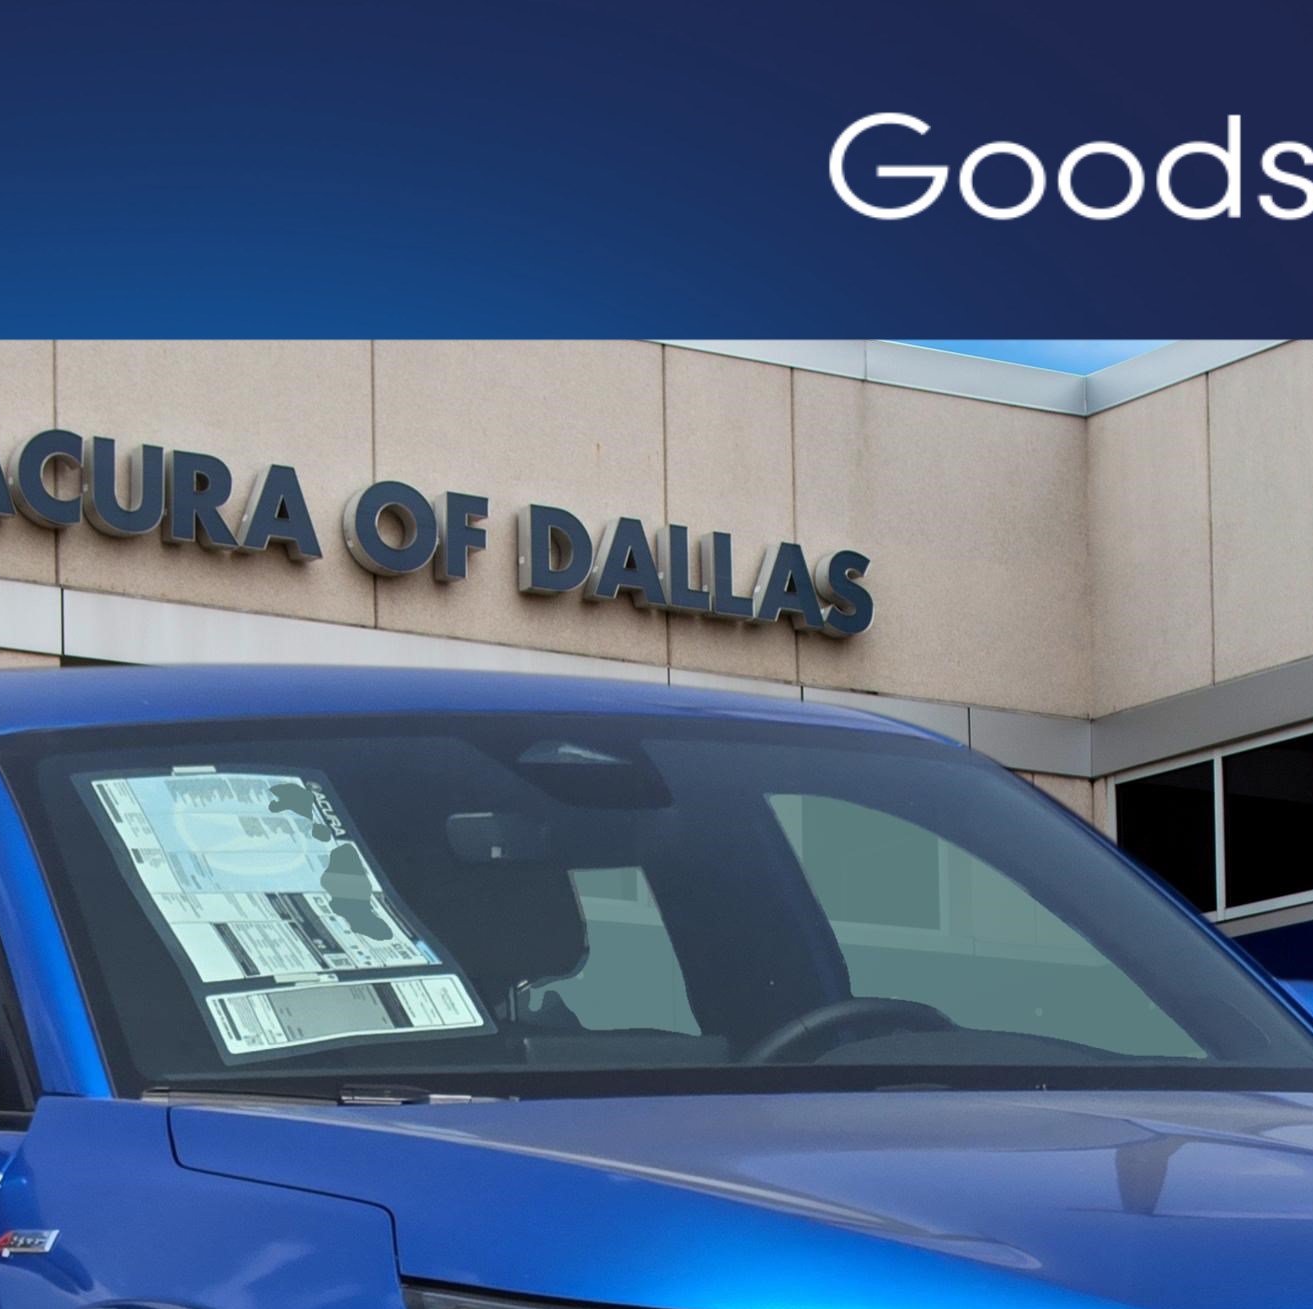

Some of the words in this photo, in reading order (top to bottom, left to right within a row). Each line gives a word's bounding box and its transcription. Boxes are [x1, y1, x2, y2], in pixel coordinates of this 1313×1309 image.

[343, 480, 488, 583] OF
[517, 502, 875, 639] DALLAS
[311, 790, 347, 837] ACURA
